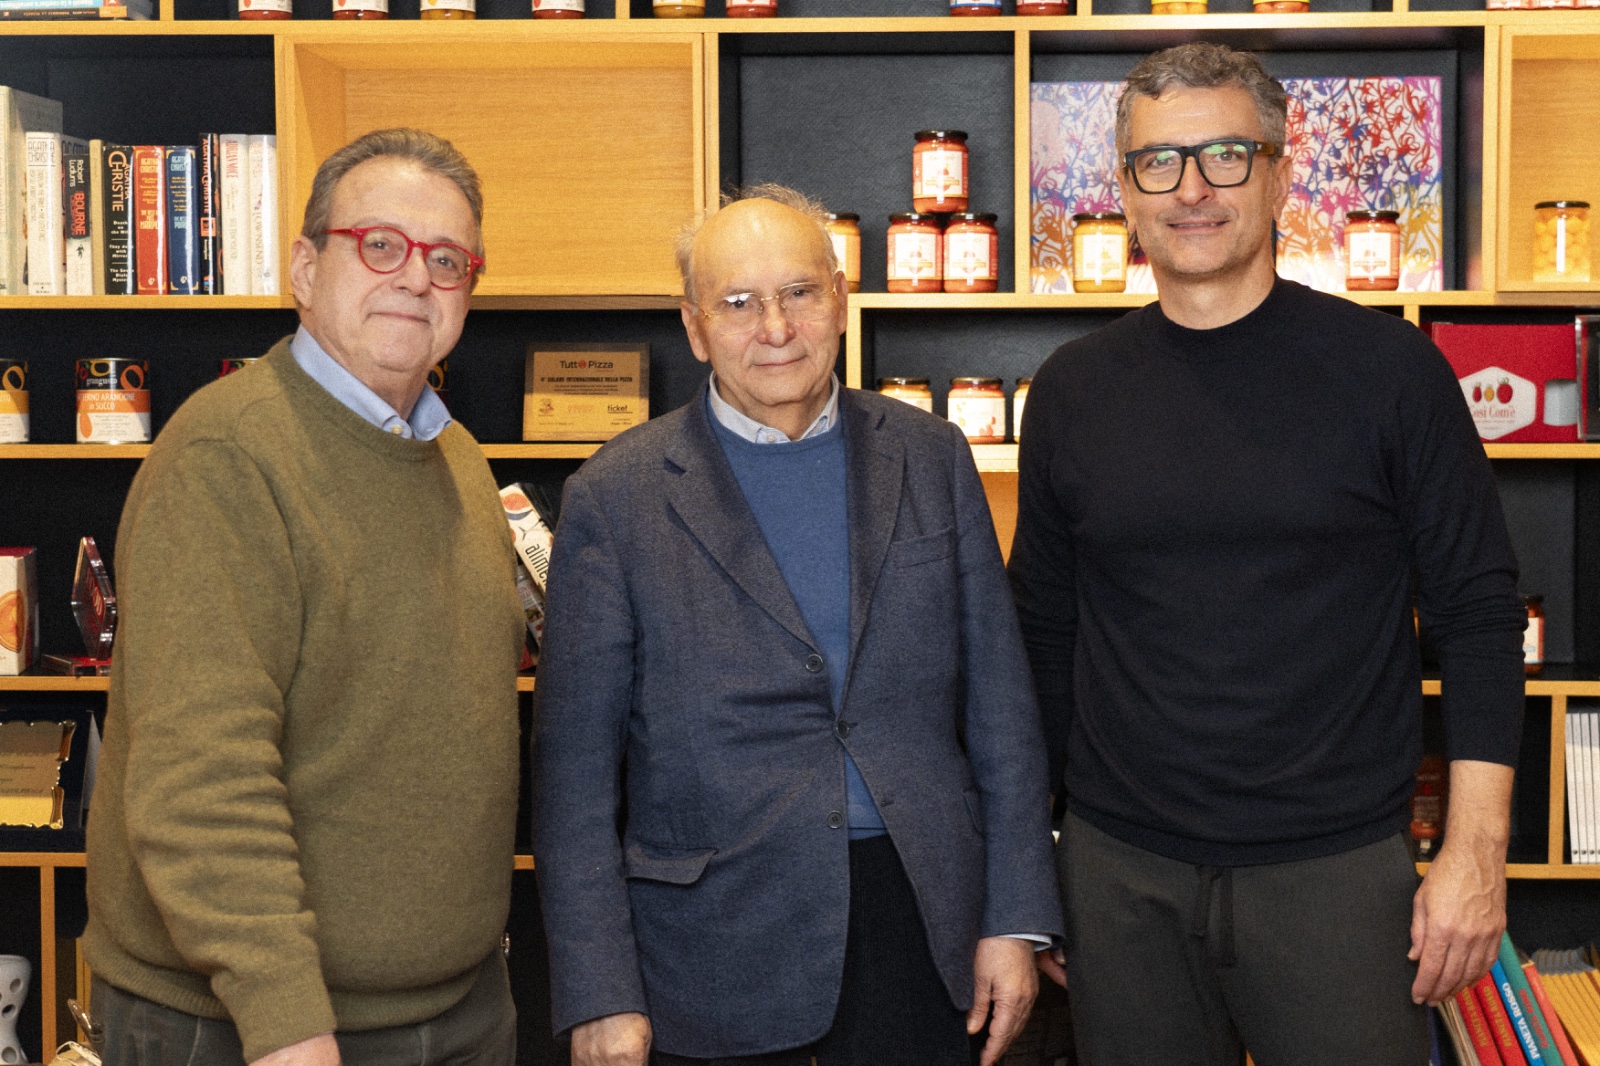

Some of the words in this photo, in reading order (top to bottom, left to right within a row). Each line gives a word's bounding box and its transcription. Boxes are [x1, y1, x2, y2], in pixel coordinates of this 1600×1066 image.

[76, 159, 85, 184] Robert
[202, 138, 210, 175] AGATHA
[108, 150, 127, 212] CHRISTIE
[201, 175, 212, 214] CHRISTIE
[75, 192, 86, 235] BOURNE
[588, 360, 613, 369] Pizza
[95, 402, 115, 410] SUCCO
[101, 393, 135, 401] ARANCIONE
[524, 542, 549, 587] alime
[1483, 985, 1498, 1012] ROSSO
[1502, 982, 1522, 1018] ROSSO
[1518, 988, 1535, 1015] ROSSO
[1494, 1012, 1512, 1047] PIANETA
[1518, 1017, 1540, 1059] PIANETA
[1530, 1014, 1550, 1048] PIANETA
